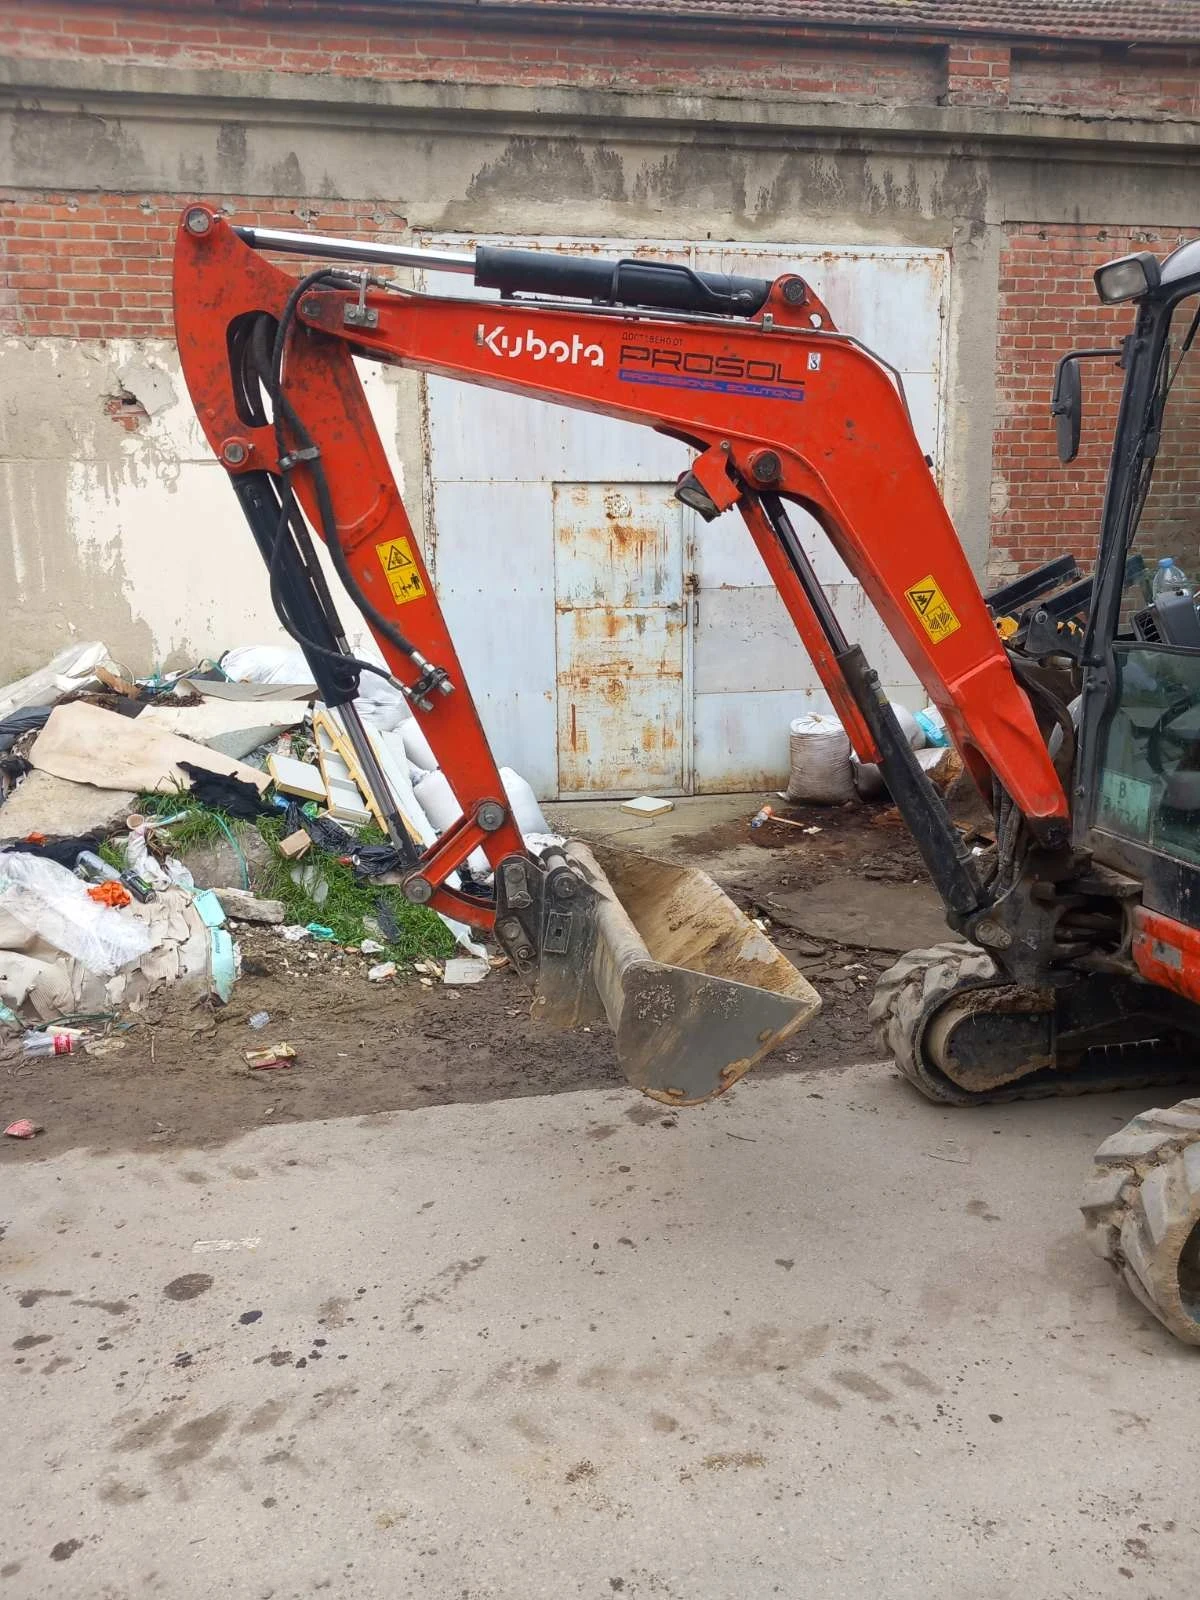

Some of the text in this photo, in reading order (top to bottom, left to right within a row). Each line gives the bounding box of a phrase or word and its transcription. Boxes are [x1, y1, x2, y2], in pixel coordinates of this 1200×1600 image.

[477, 324, 604, 367] Kubota
[620, 345, 805, 385] PROSOL
[727, 383, 801, 399] SOLUTIONS
